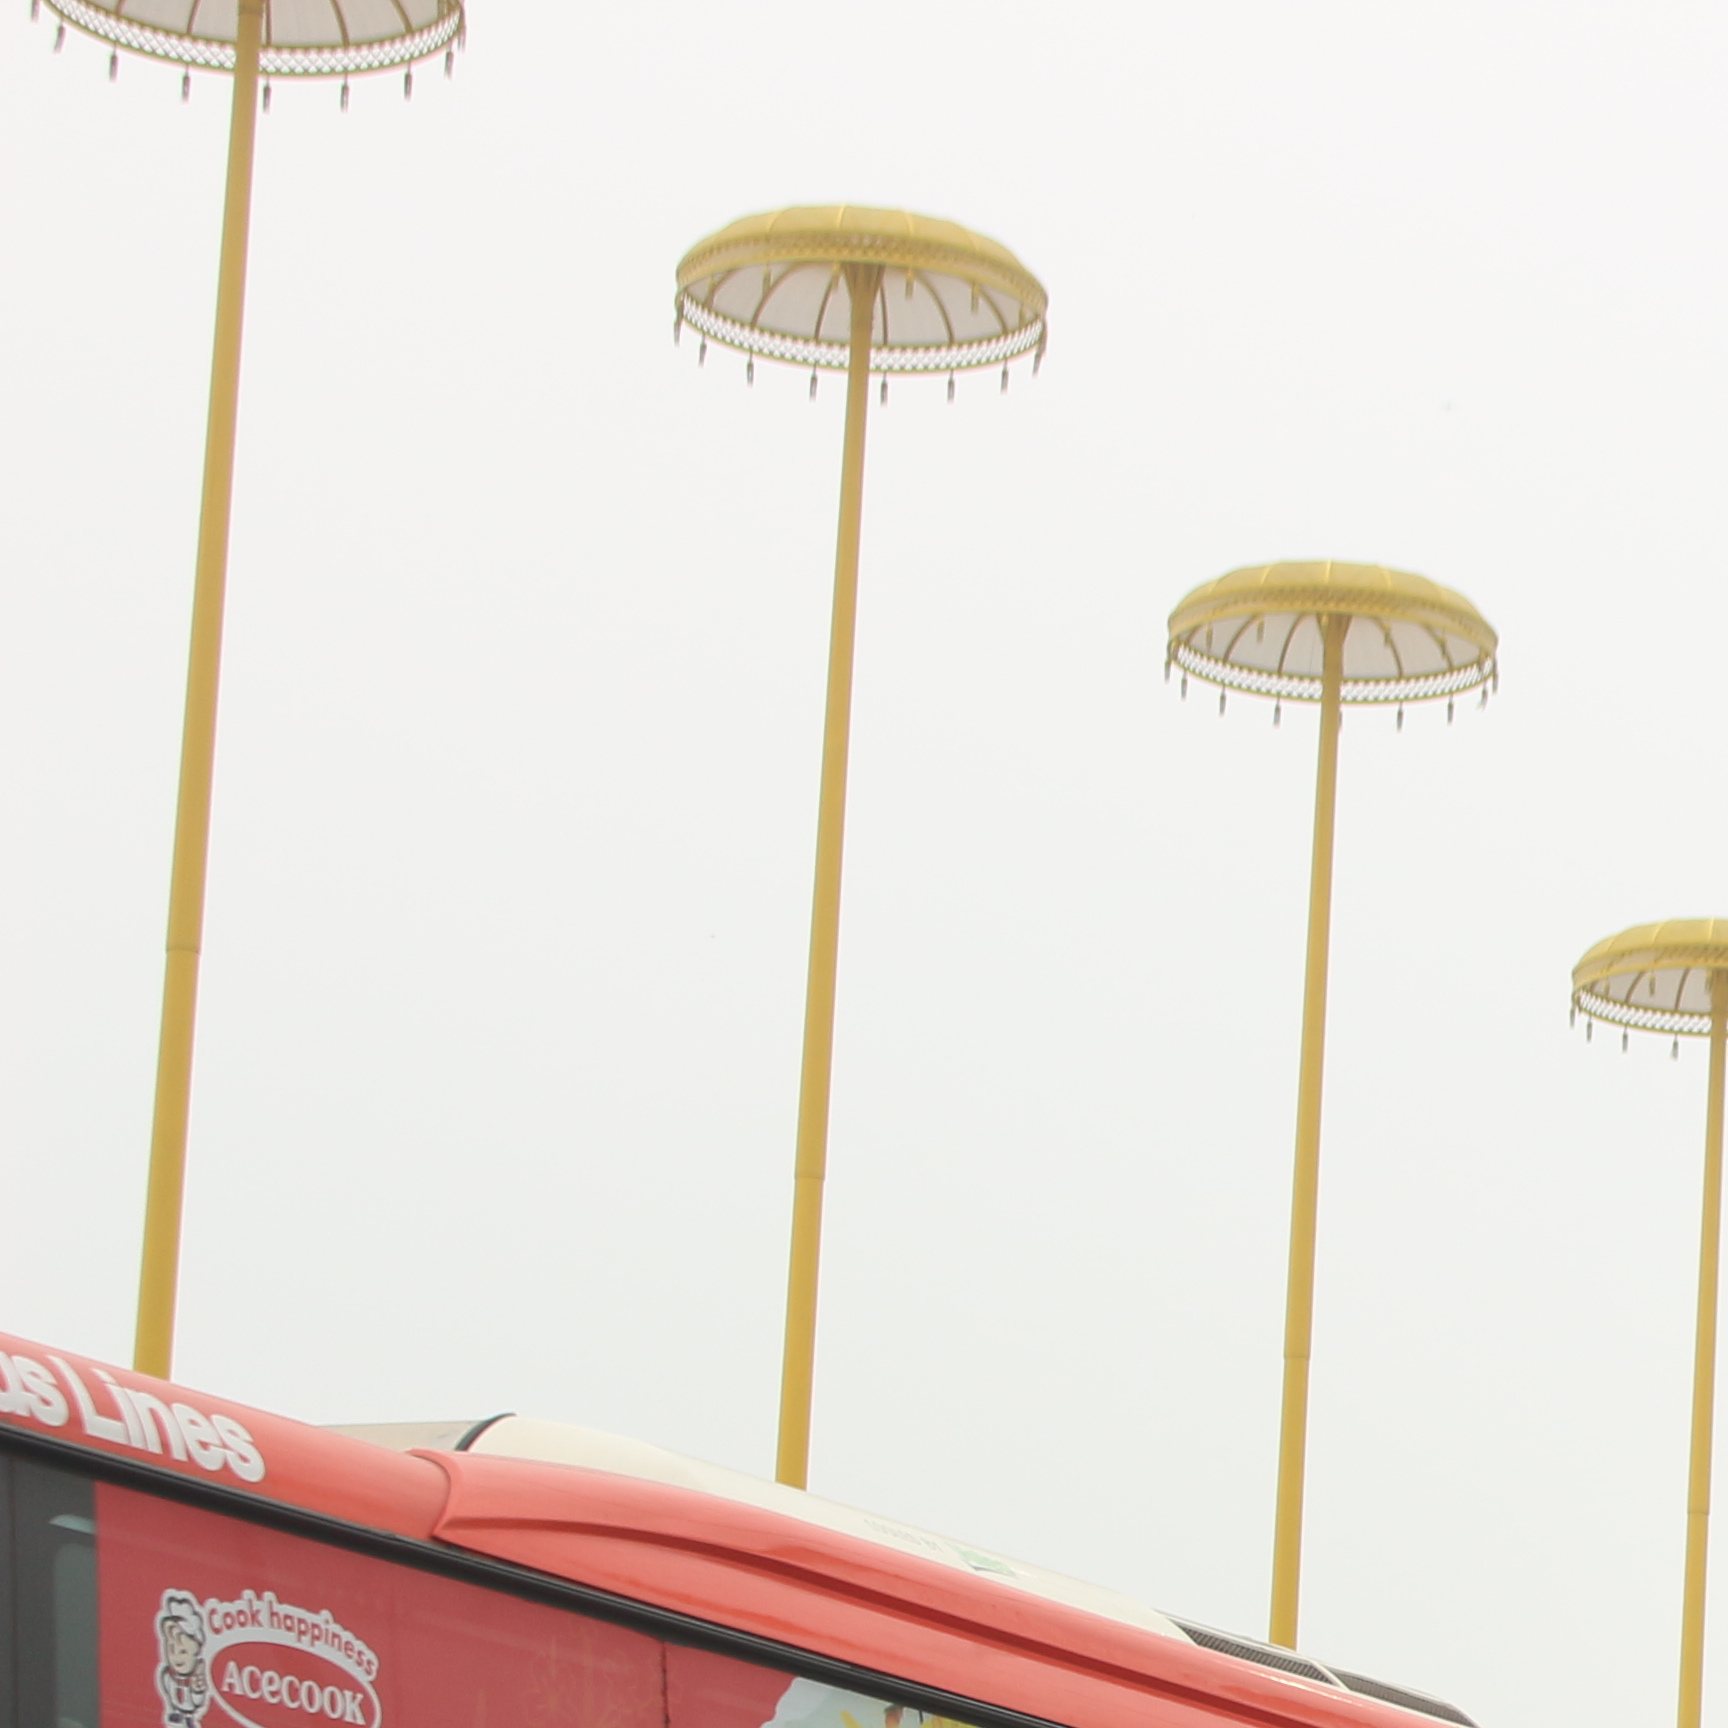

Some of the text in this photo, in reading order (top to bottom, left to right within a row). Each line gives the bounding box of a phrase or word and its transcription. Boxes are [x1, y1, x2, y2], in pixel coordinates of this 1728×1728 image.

[47, 1354, 267, 1483] Lines
[208, 1598, 377, 1676] Cook happiness
